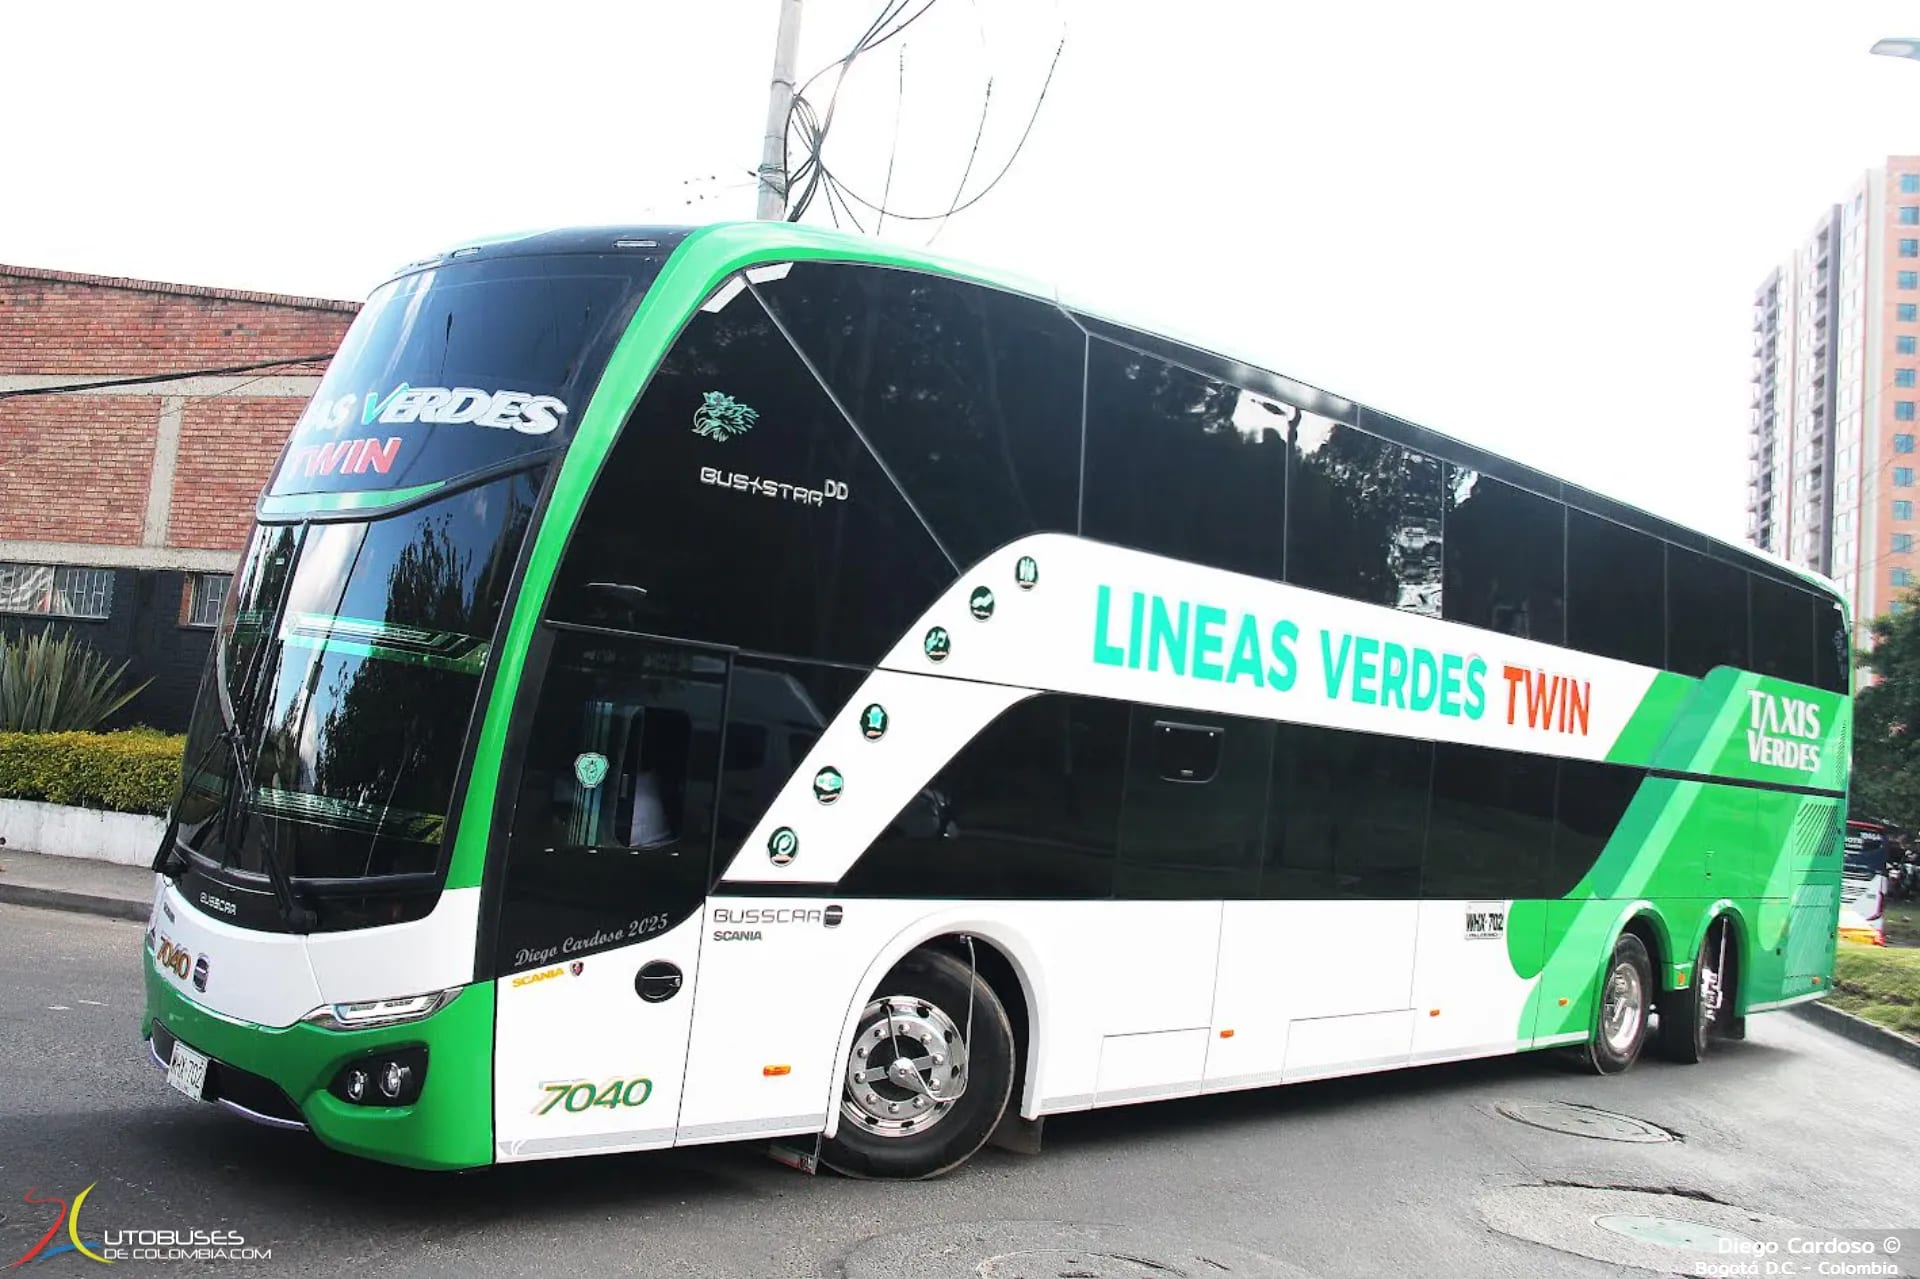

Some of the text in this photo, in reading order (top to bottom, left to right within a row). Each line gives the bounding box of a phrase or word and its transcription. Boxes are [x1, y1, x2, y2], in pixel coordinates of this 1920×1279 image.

[361, 382, 568, 435] VERDES
[288, 437, 402, 478] TWIN
[824, 479, 849, 500] DD
[1093, 585, 1591, 736] LINEAS VERDES TWIN
[1747, 689, 1820, 740] TAXIS
[1746, 728, 1821, 773] VERDES
[200, 891, 237, 916] BUSSCAR
[713, 908, 822, 924] BUSSCAR
[713, 930, 762, 941] SCANIA
[157, 935, 192, 980] 7040
[512, 967, 565, 988] SCANIA
[536, 1078, 653, 1115] 7040
